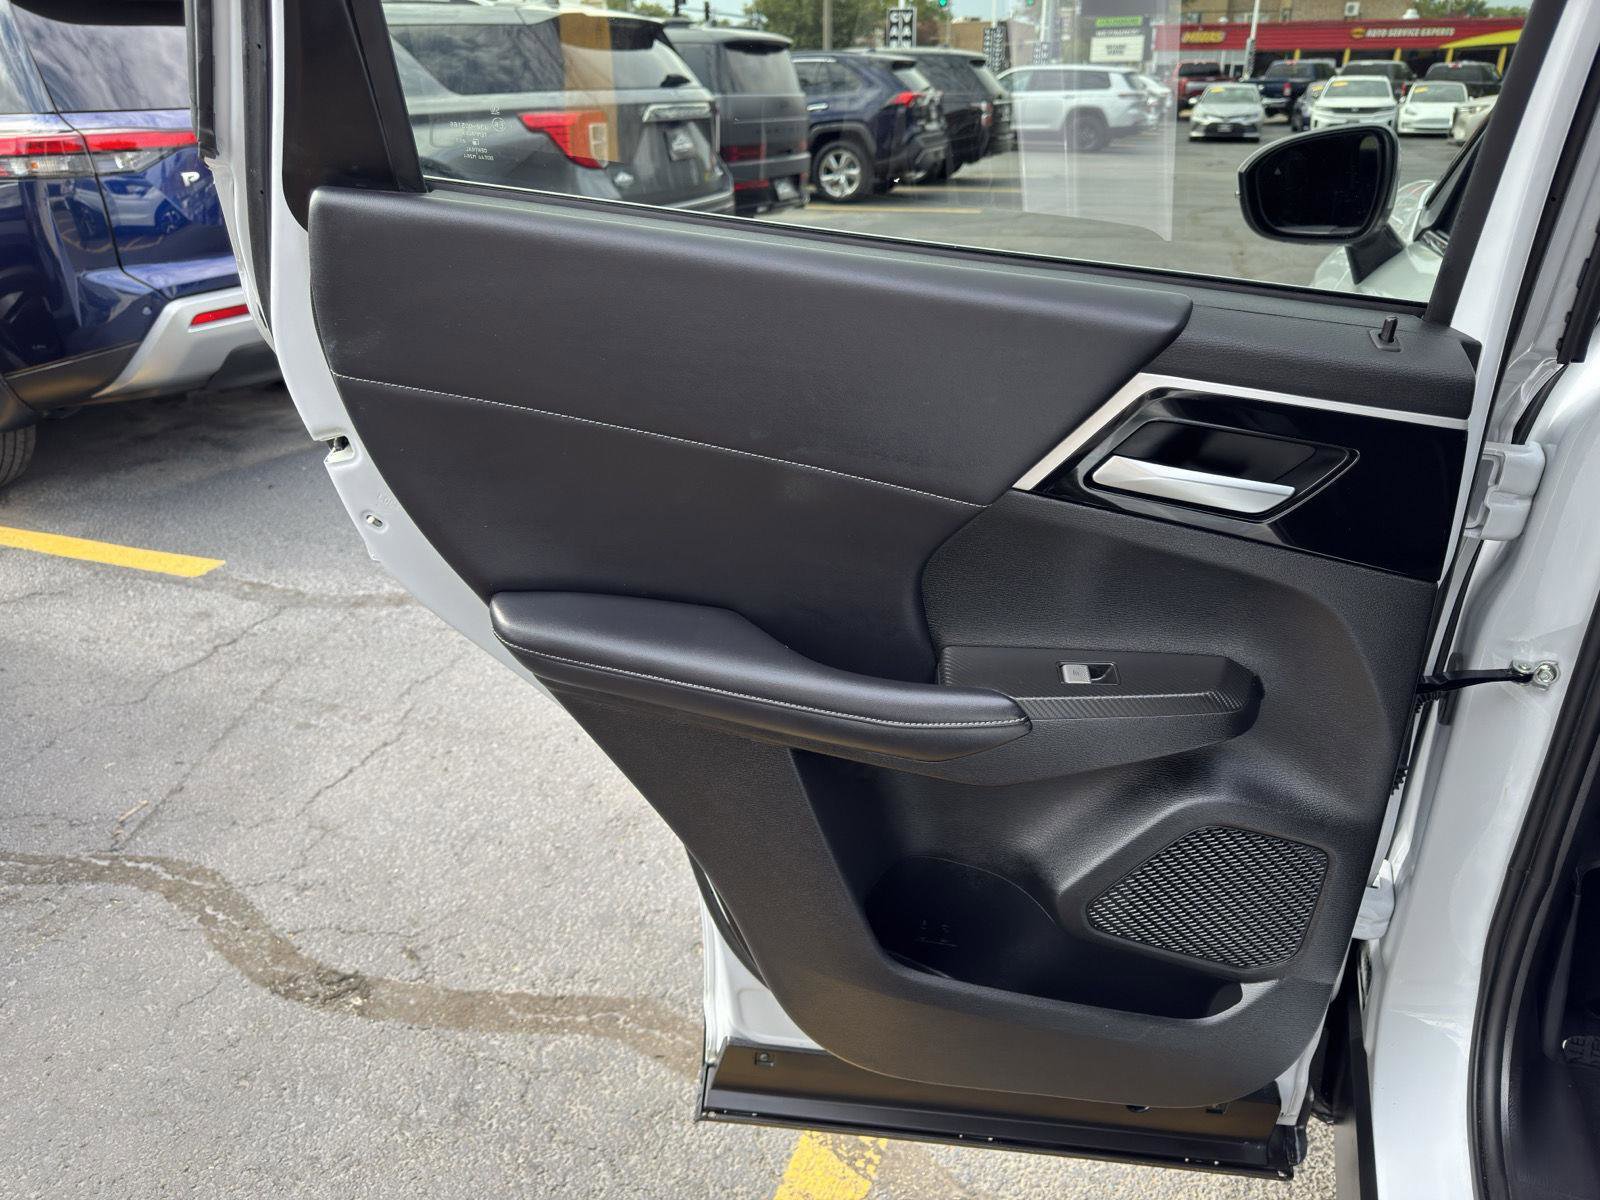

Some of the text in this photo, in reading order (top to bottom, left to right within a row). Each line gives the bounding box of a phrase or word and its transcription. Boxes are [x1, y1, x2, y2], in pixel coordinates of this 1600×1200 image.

[1365, 28, 1387, 37] AUTO
[1388, 28, 1420, 37] SERVICE
[1420, 27, 1456, 36] EXPERTS
